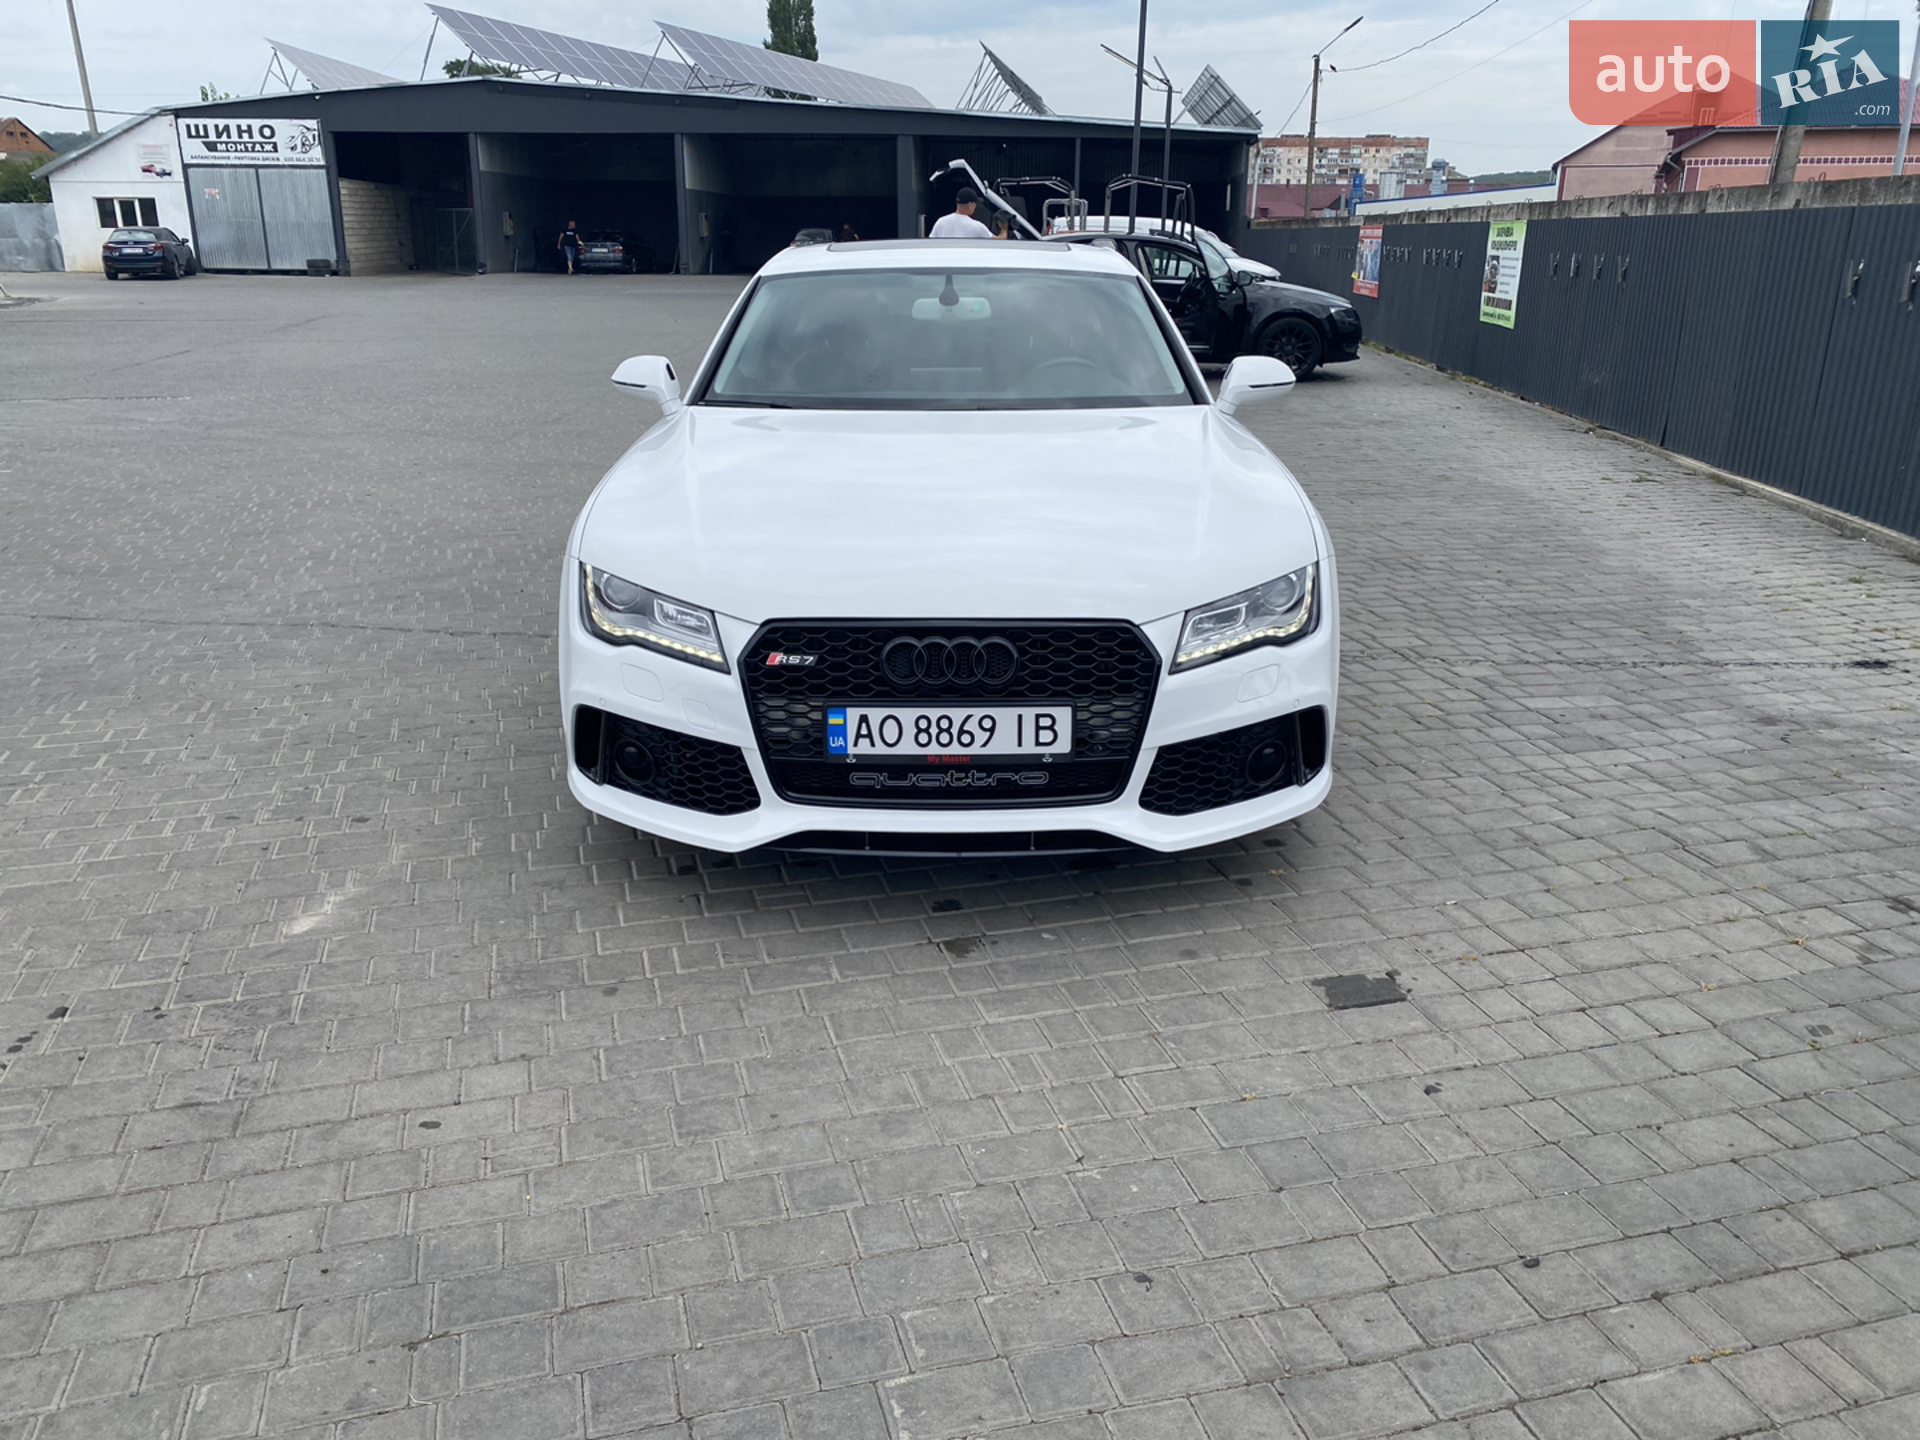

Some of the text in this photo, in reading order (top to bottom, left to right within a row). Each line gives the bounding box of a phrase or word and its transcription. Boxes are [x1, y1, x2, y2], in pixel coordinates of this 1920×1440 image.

[185, 123, 276, 140] ШИНО
[216, 142, 275, 152] МОНТАЖ
[772, 654, 815, 665] RS7
[853, 713, 1059, 748] AO 8869 IB
[829, 736, 846, 748] UA
[927, 754, 971, 764] My Master
[849, 769, 1049, 789] quattro
